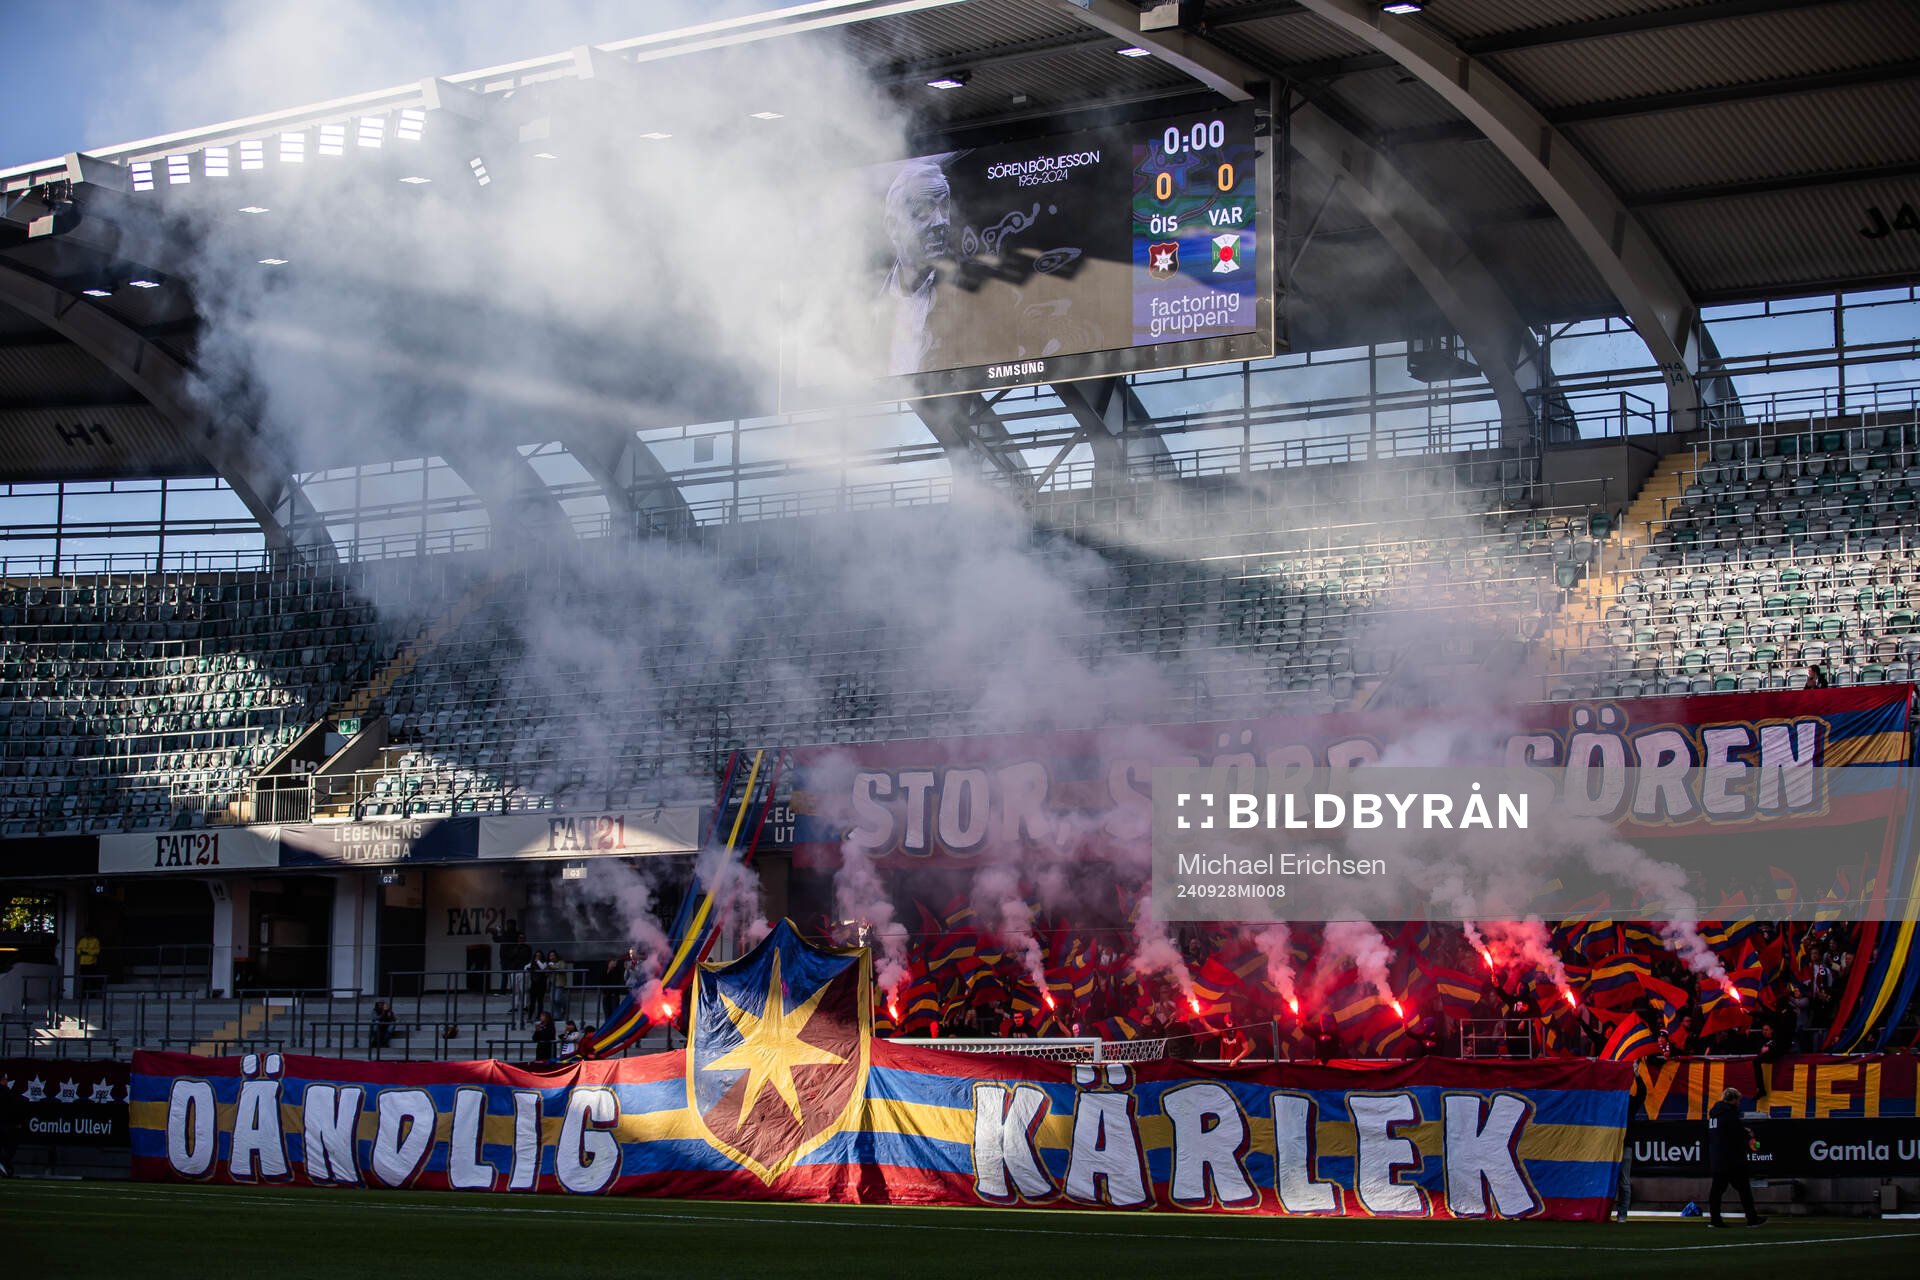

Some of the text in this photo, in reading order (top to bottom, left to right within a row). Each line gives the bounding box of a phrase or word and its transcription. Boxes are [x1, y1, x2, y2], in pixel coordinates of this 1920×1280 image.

[1164, 120, 1224, 154] 0:00
[987, 150, 1100, 180] SÖREN BÖRJESSON
[1018, 169, 1068, 187] 1956-2024
[1218, 163, 1234, 191] 0
[1156, 172, 1172, 200] 0
[1150, 213, 1178, 234] ÖIS
[1208, 206, 1243, 226] VAR
[1150, 291, 1240, 317] factoring
[1150, 309, 1229, 338] gruppen
[988, 361, 1044, 379] SAMSUNG
[1505, 707, 1820, 818] SÖREN
[333, 824, 422, 843] LEGENDENS
[547, 814, 627, 852] FAT21
[154, 833, 221, 868] FAT21
[342, 843, 412, 860] UTVALDA
[29, 1118, 112, 1135] Gamla Ullevi
[165, 1053, 625, 1196] OÄNDLIG
[970, 1062, 1545, 1222] KÄRLEK
[1634, 1140, 1701, 1162] Ullevi
[1809, 1140, 1890, 1161] Gamla
[1751, 1153, 1773, 1161] Event
